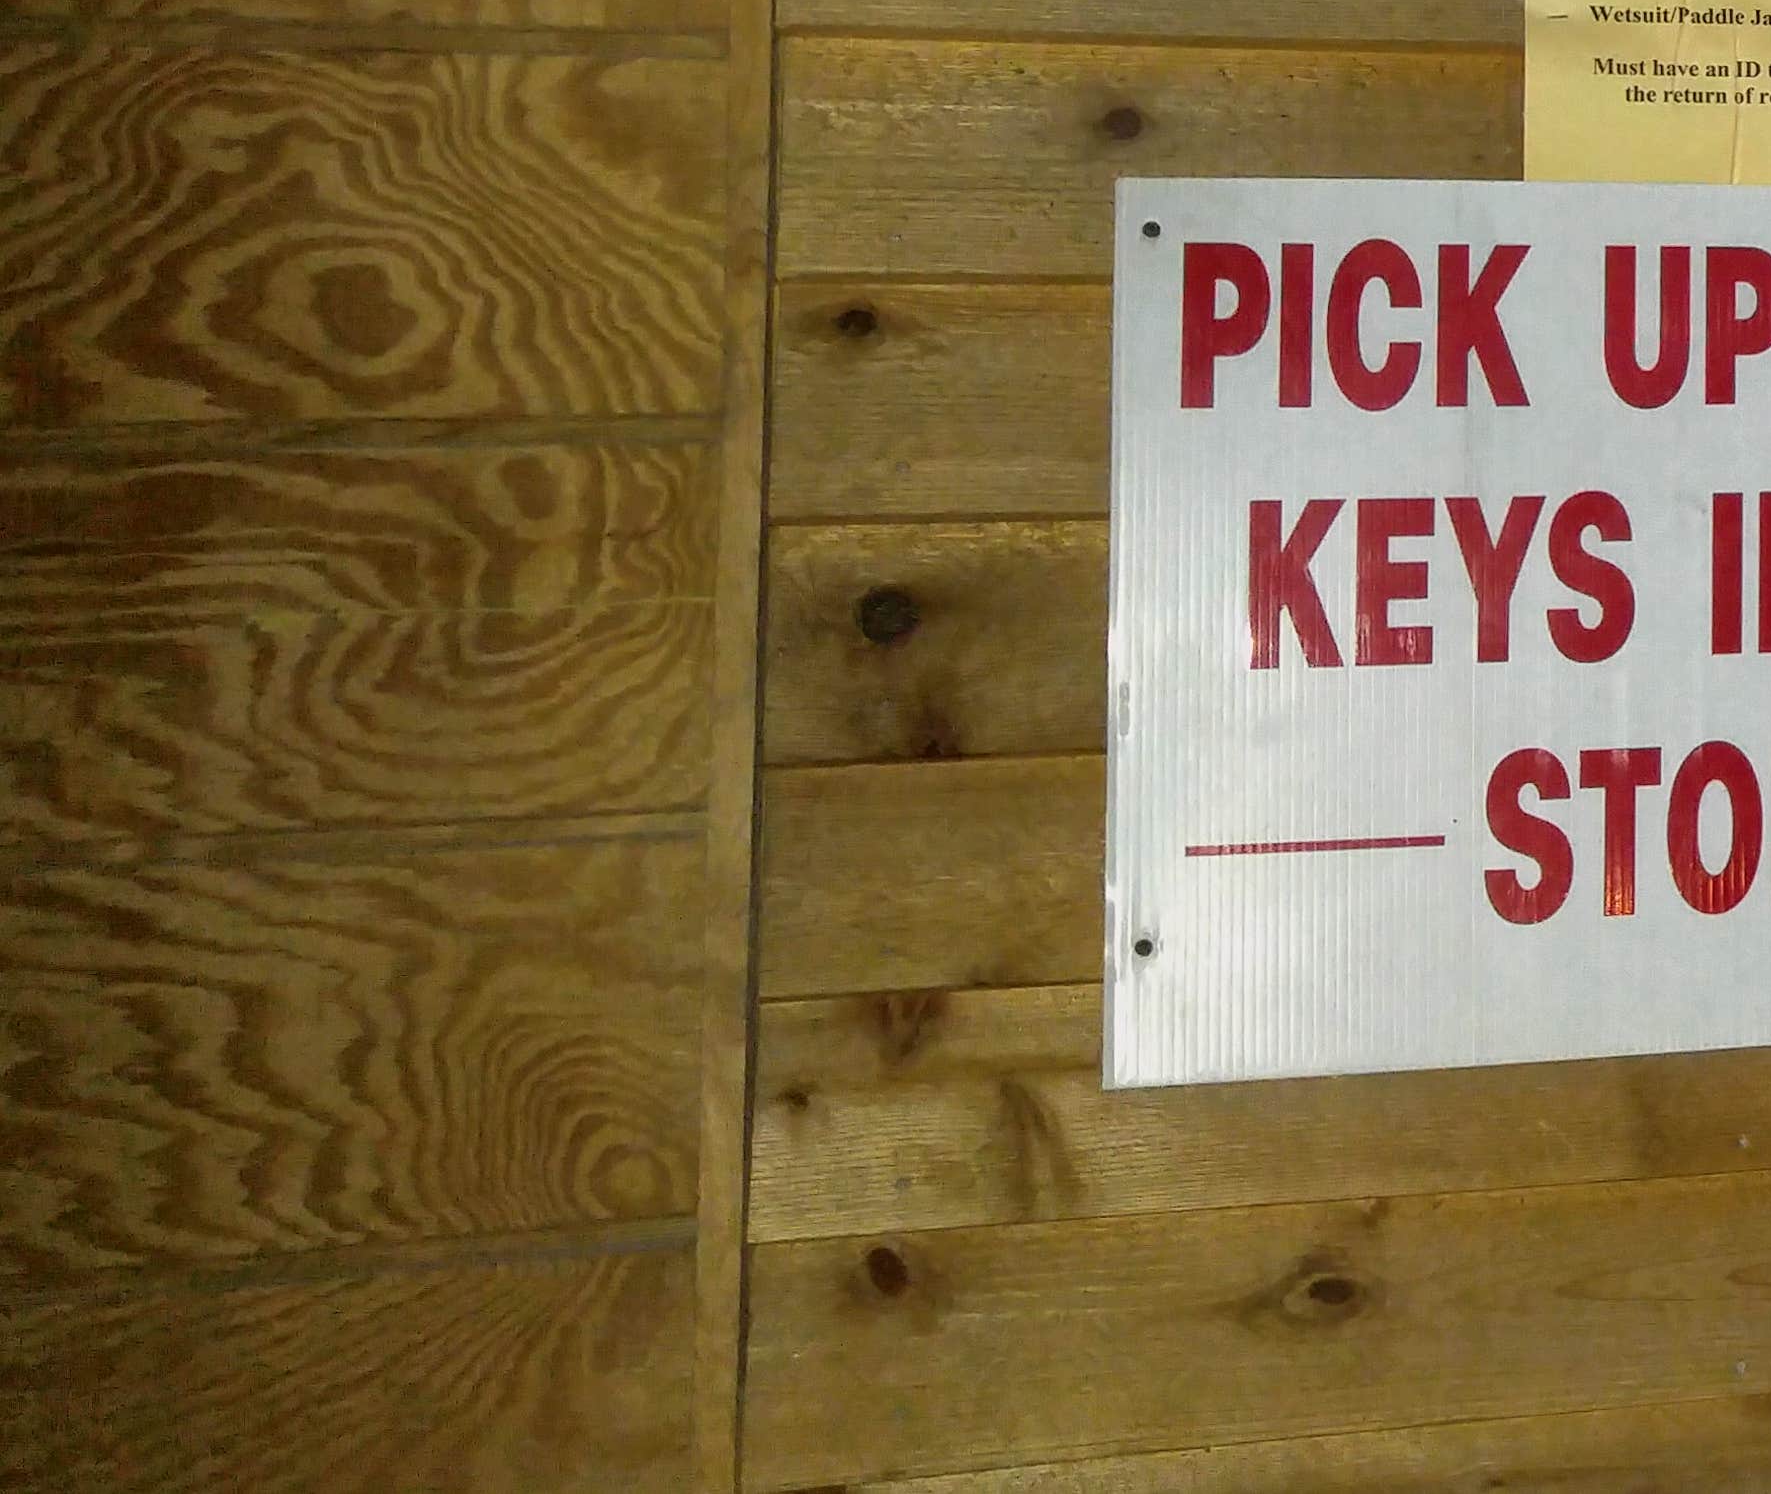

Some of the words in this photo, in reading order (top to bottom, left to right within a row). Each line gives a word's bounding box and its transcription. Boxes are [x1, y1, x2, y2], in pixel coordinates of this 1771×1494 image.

[1588, 5, 1745, 25] Wetsuit/Paddle
[1593, 58, 1646, 76] Must
[1653, 59, 1699, 77] have
[1706, 64, 1729, 78] an
[1736, 61, 1760, 78] ID
[1625, 86, 1657, 103] the
[1663, 88, 1727, 104] return
[1734, 88, 1755, 105] of
[1179, 237, 1533, 413] PICK
[1248, 489, 1637, 671] KEYS
